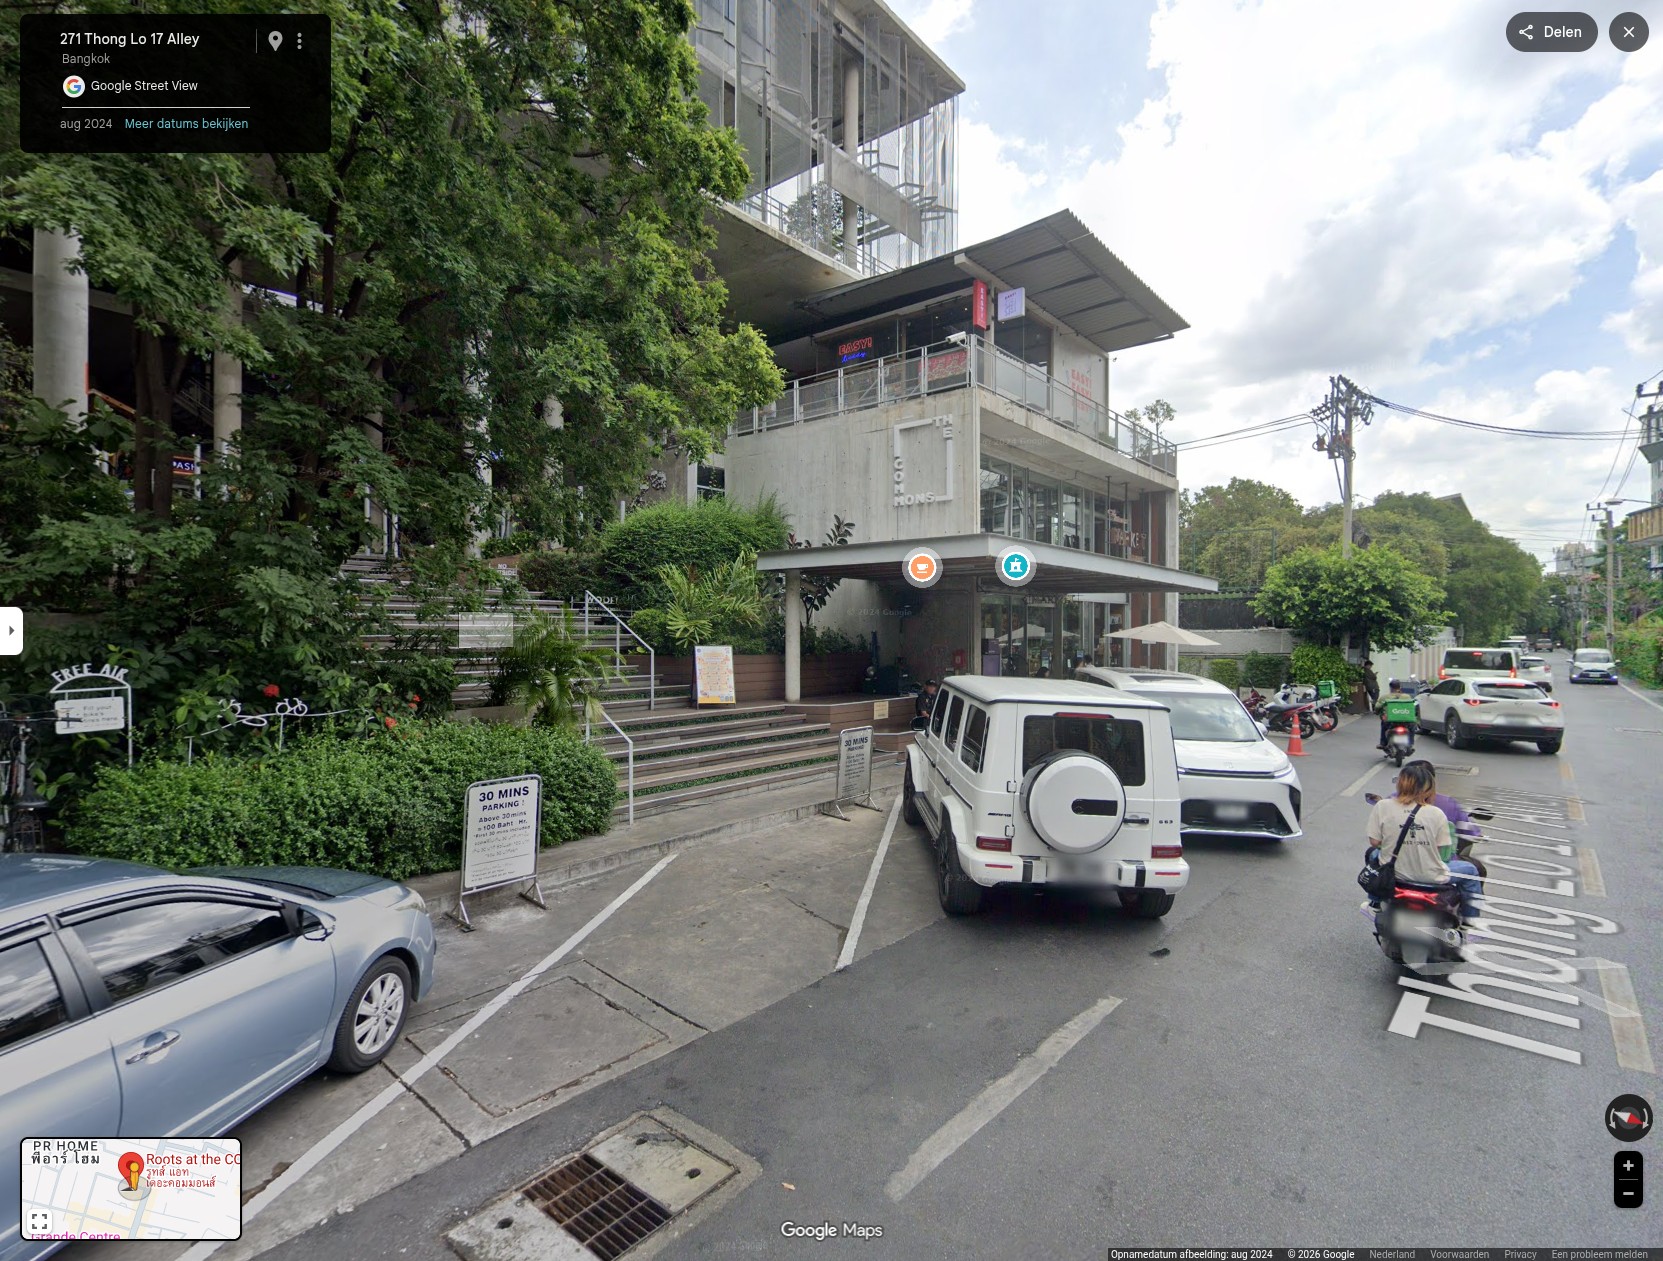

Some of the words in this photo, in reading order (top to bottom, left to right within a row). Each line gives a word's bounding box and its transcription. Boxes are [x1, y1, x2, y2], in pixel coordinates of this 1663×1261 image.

[838, 336, 873, 356] EASY!
[50, 663, 93, 683] FREE
[100, 663, 130, 681] AIR
[844, 739, 852, 747] 30
[852, 736, 869, 746] MINS
[478, 791, 494, 802] 30
[498, 786, 530, 800] MINS
[482, 800, 520, 812] PARKING
[478, 815, 500, 823] Above
[497, 820, 514, 829] Baht
